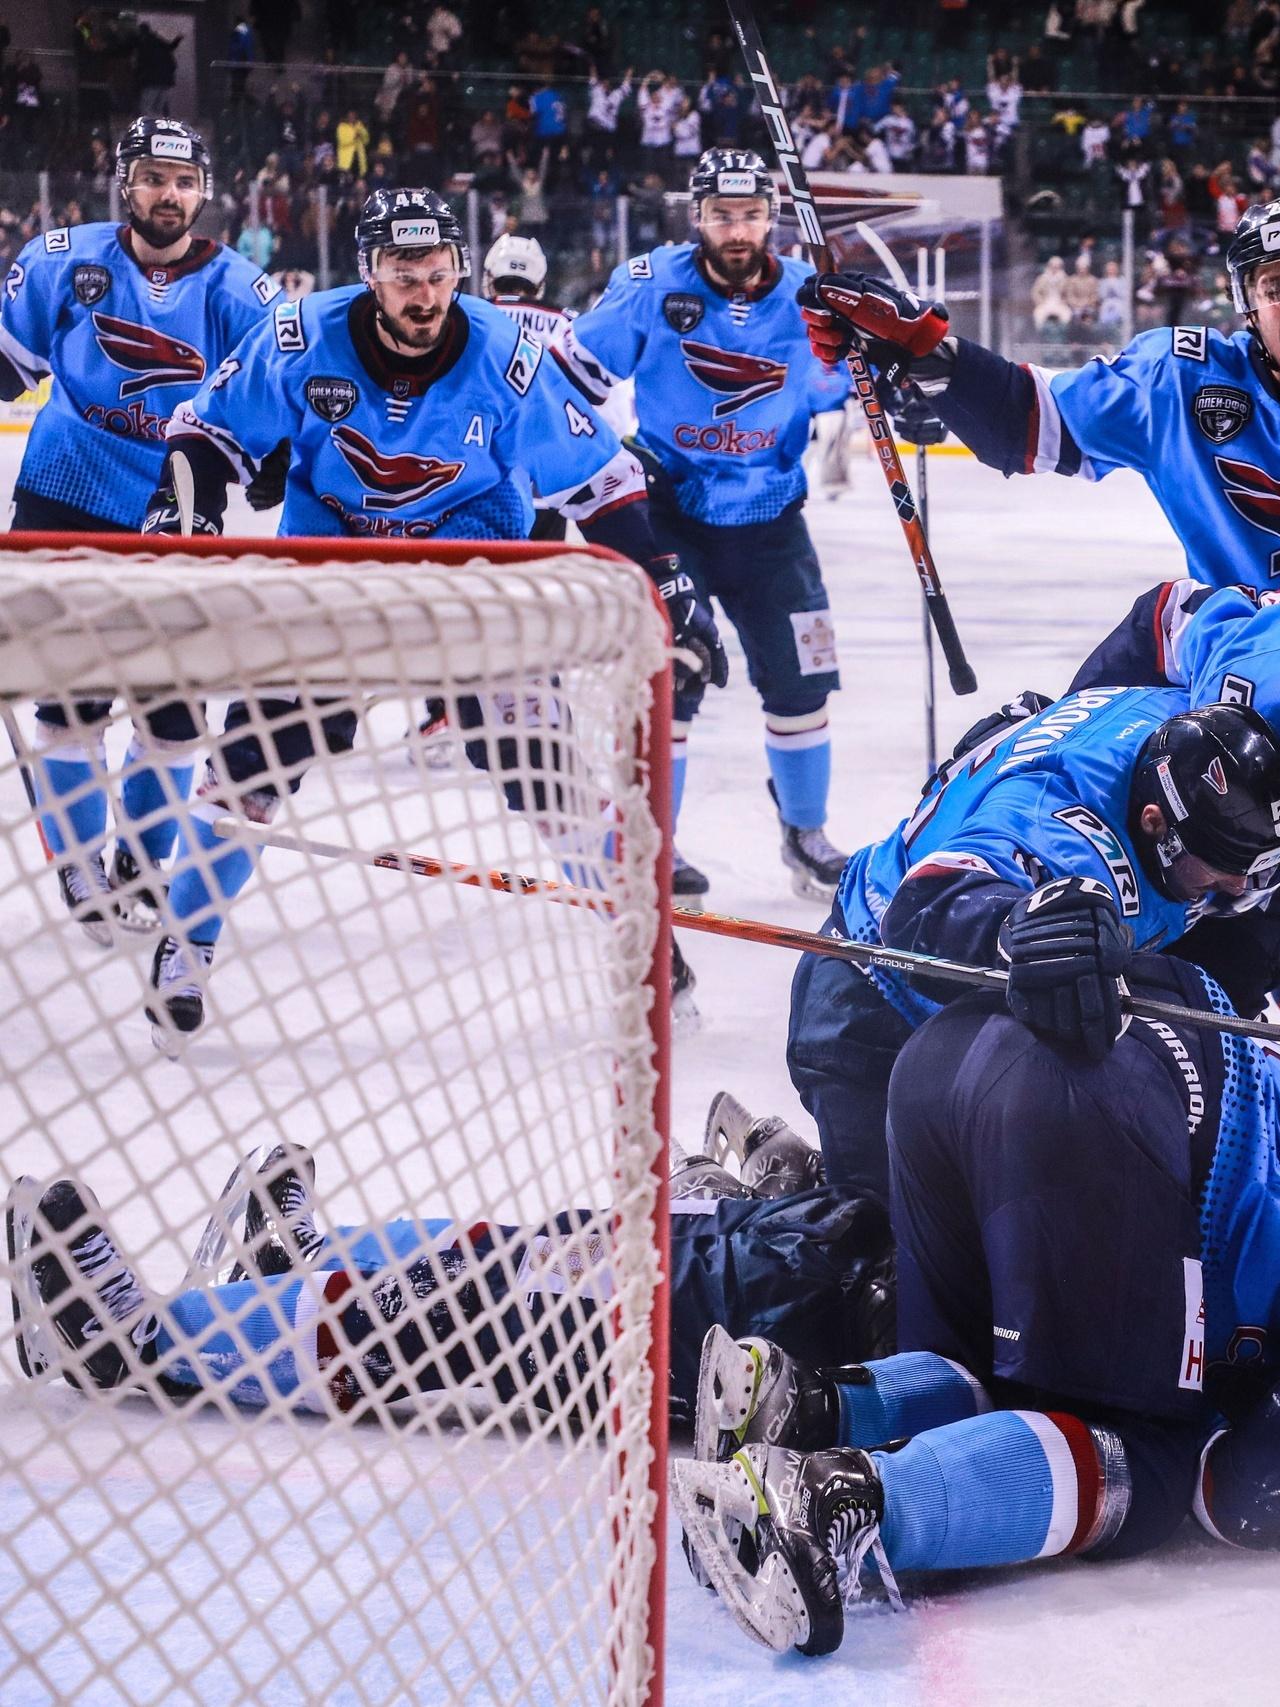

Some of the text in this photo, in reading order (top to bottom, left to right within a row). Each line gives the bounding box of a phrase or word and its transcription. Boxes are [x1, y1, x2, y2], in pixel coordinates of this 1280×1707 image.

[155, 141, 188, 151] PARI
[751, 50, 826, 246] TRUE
[396, 226, 435, 238] PARI
[827, 291, 859, 308] CCM
[279, 303, 301, 348] ARI
[1178, 328, 1202, 358] RI
[848, 355, 896, 471] RDUS 9X
[463, 415, 484, 447] A
[1060, 806, 1138, 912] PARI
[869, 955, 915, 971] HZRDUS
[993, 1325, 1021, 1341] RRIOR
